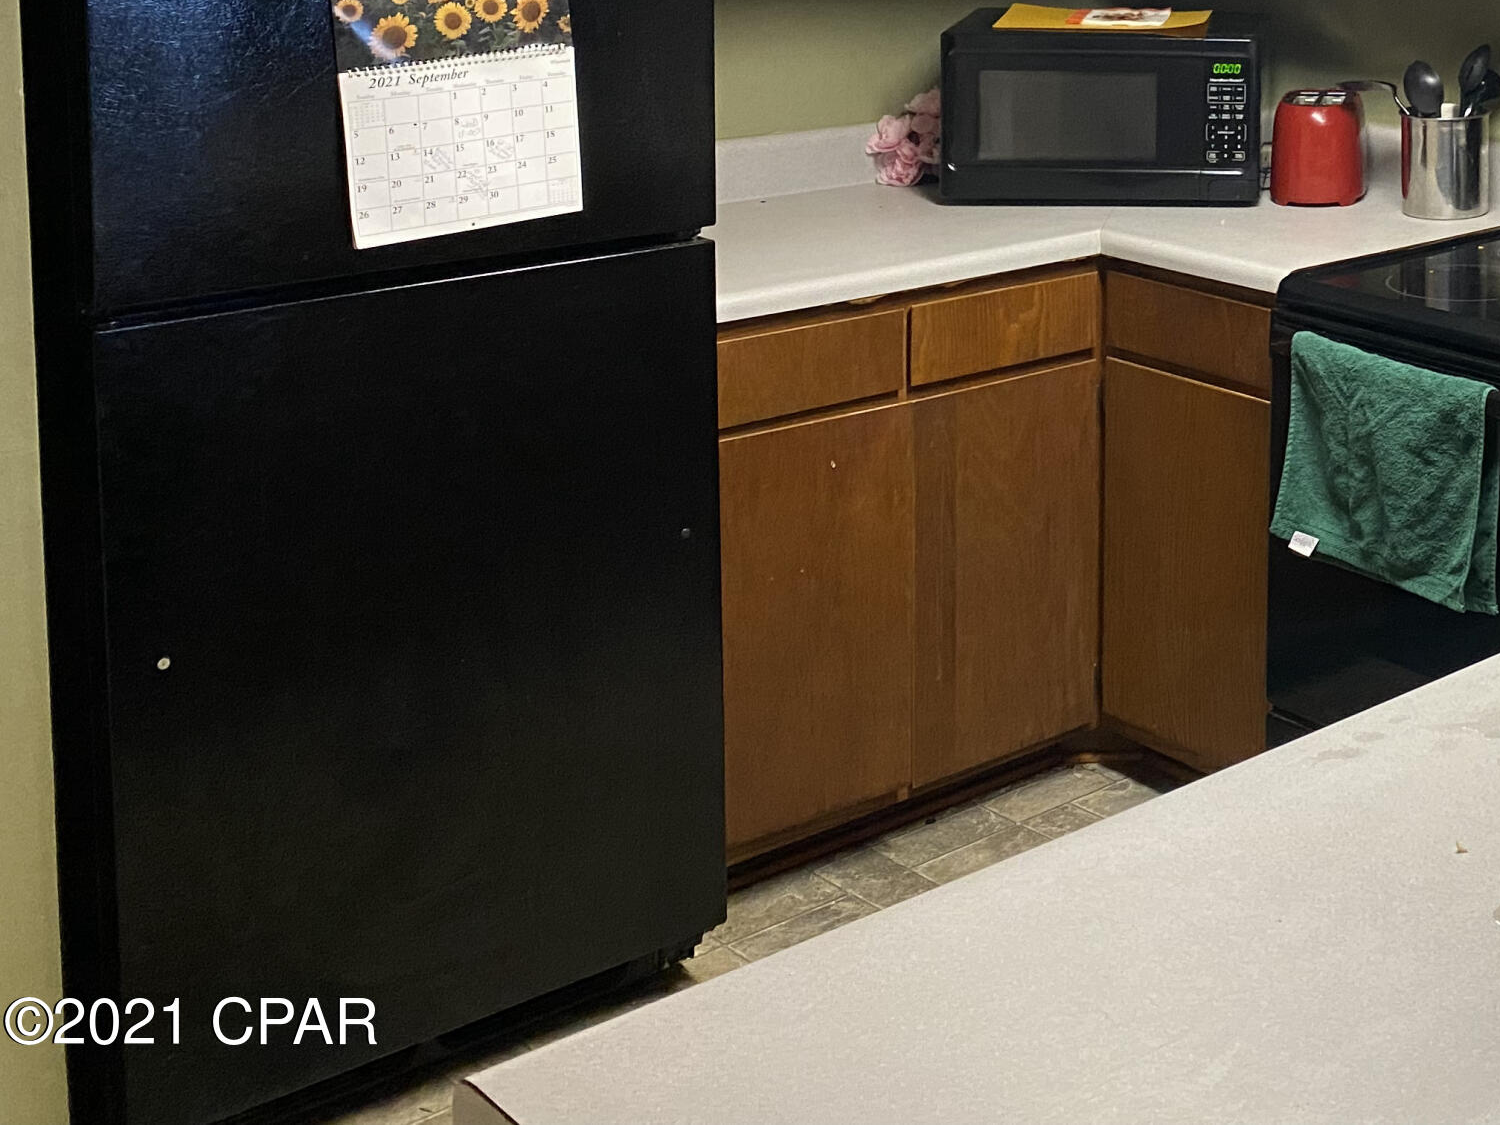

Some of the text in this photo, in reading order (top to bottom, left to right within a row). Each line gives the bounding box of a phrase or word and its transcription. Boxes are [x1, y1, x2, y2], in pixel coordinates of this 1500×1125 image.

[368, 68, 469, 89] 2021 September
[514, 109, 523, 117] 10
[545, 105, 553, 113] 11
[355, 157, 365, 166] 12
[390, 153, 401, 161] 13
[456, 144, 465, 152] 15
[486, 139, 495, 147] 16
[516, 135, 524, 143] 17
[357, 156, 557, 193] 19 20 21 22 23 24 25
[358, 190, 499, 220] 26 27 28 29 30
